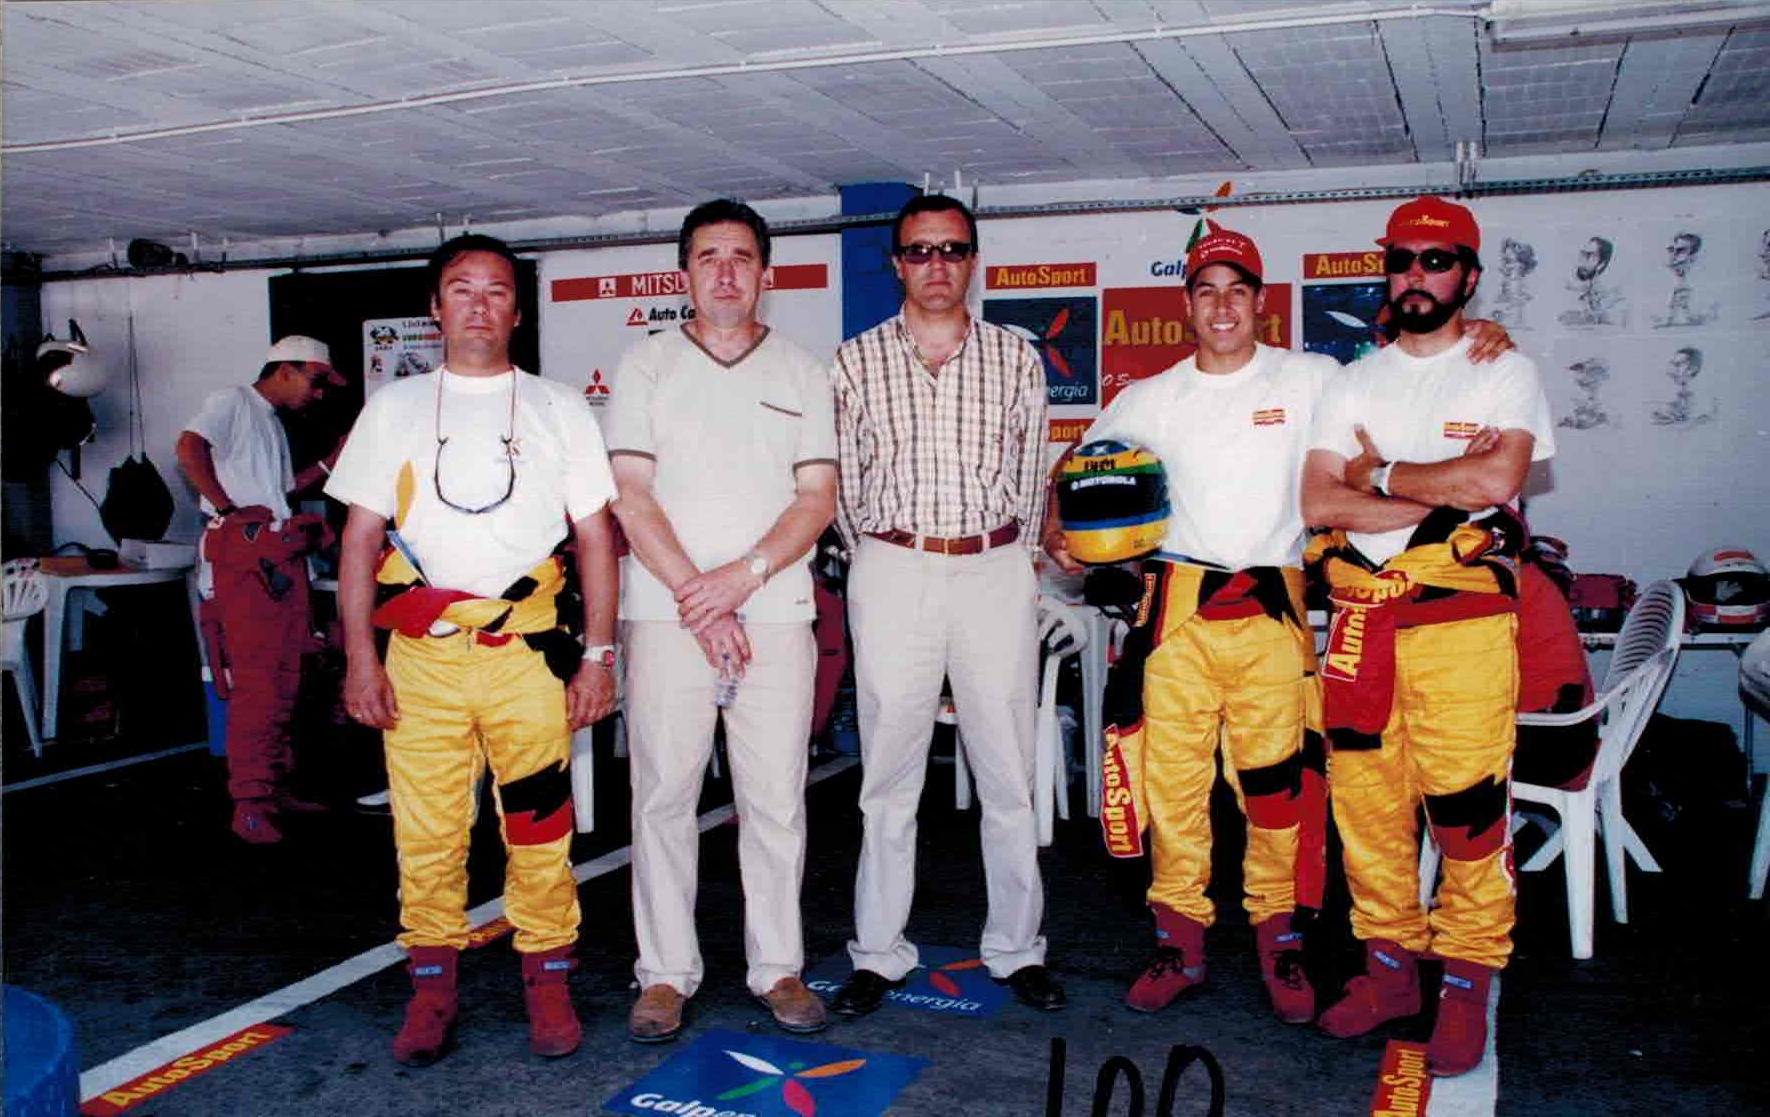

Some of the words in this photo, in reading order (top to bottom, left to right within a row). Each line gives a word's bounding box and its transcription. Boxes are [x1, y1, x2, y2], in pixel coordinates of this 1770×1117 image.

[995, 265, 1087, 286] AutoSport
[649, 307, 677, 321] Auto
[102, 1031, 271, 1107] AutoSport
